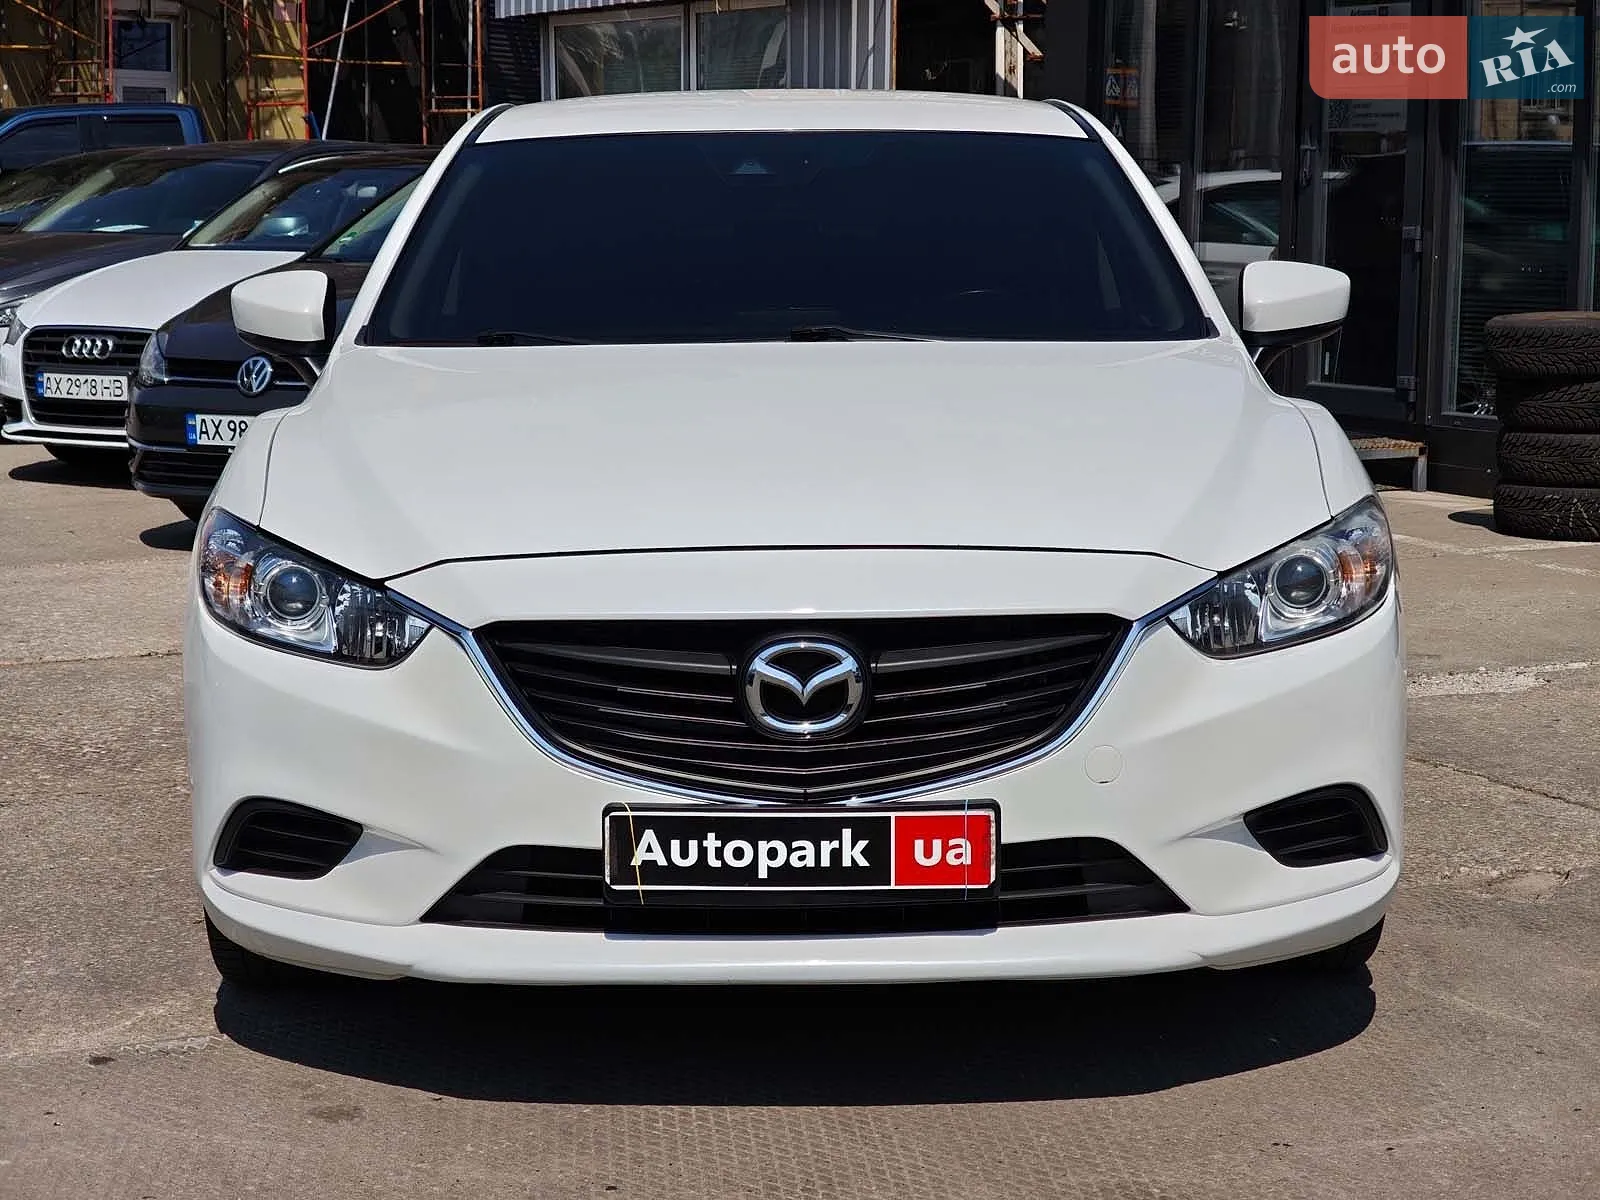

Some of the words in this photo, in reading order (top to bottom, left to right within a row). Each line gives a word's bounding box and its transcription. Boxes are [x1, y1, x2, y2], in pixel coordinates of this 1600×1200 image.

[45, 377, 63, 396] AX
[66, 377, 98, 397] 2918
[101, 379, 124, 398] HB
[199, 418, 224, 441] AX
[630, 828, 870, 879] Autopark
[914, 838, 972, 866] ua
